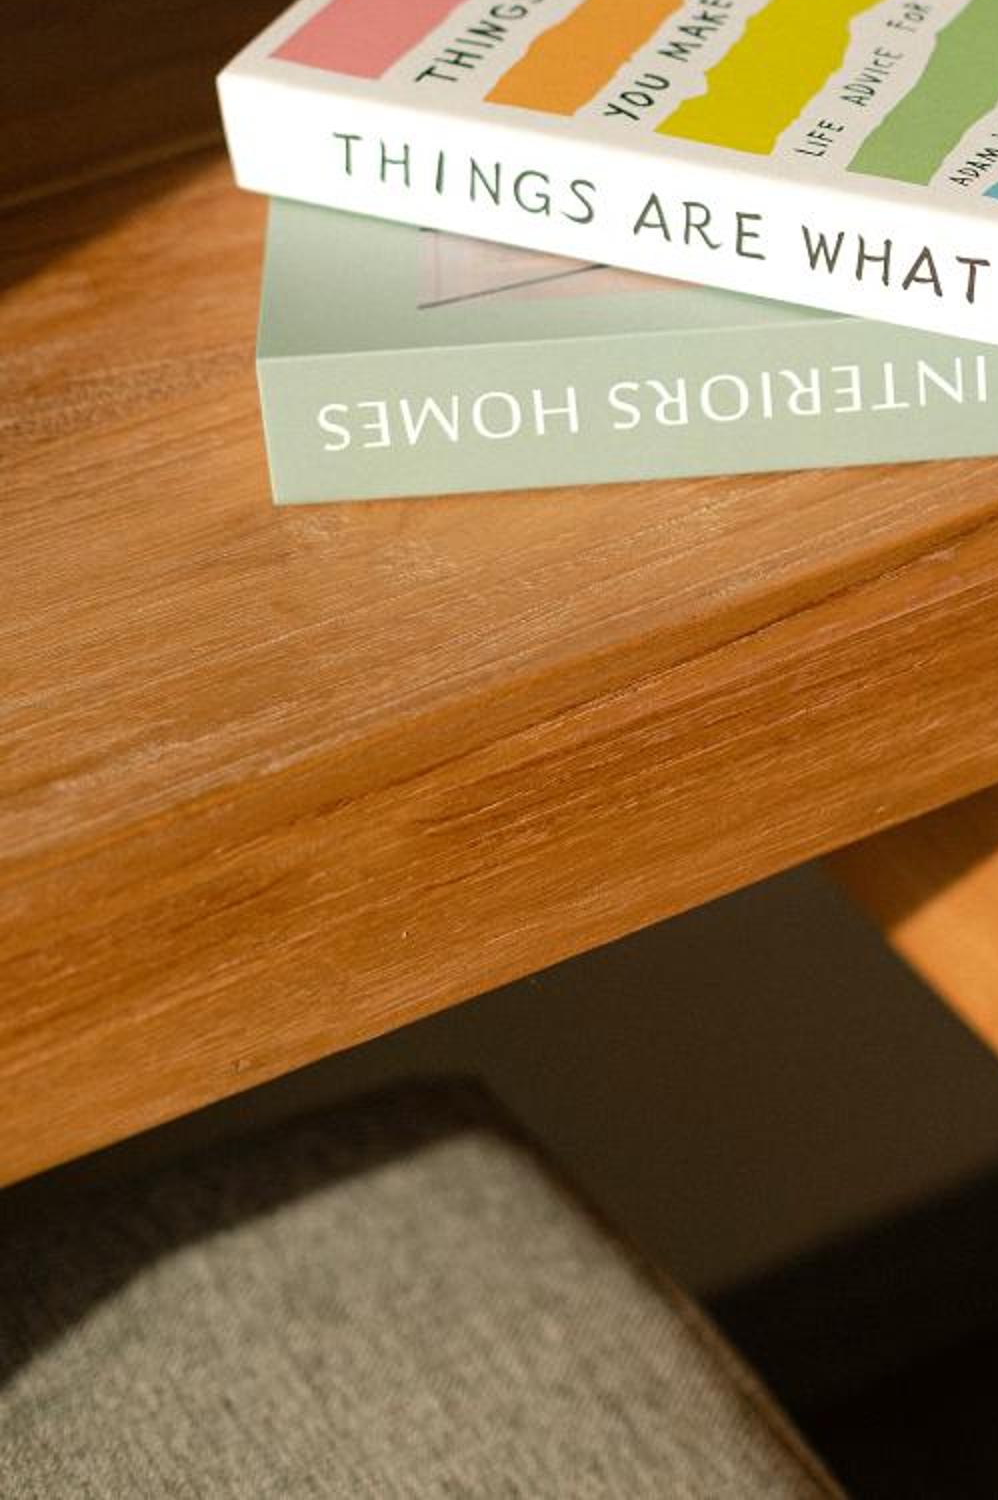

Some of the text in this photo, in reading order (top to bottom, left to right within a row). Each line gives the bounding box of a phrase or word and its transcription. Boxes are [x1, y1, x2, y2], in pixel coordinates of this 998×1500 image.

[603, 72, 671, 122] YOU
[793, 118, 846, 158] LIFE
[839, 45, 904, 108] ADVICE
[885, 1, 932, 33] FOR
[332, 131, 992, 305] THINGS ARE WHAT
[317, 386, 580, 452] HOMES
[607, 355, 988, 430] INTERIORS
